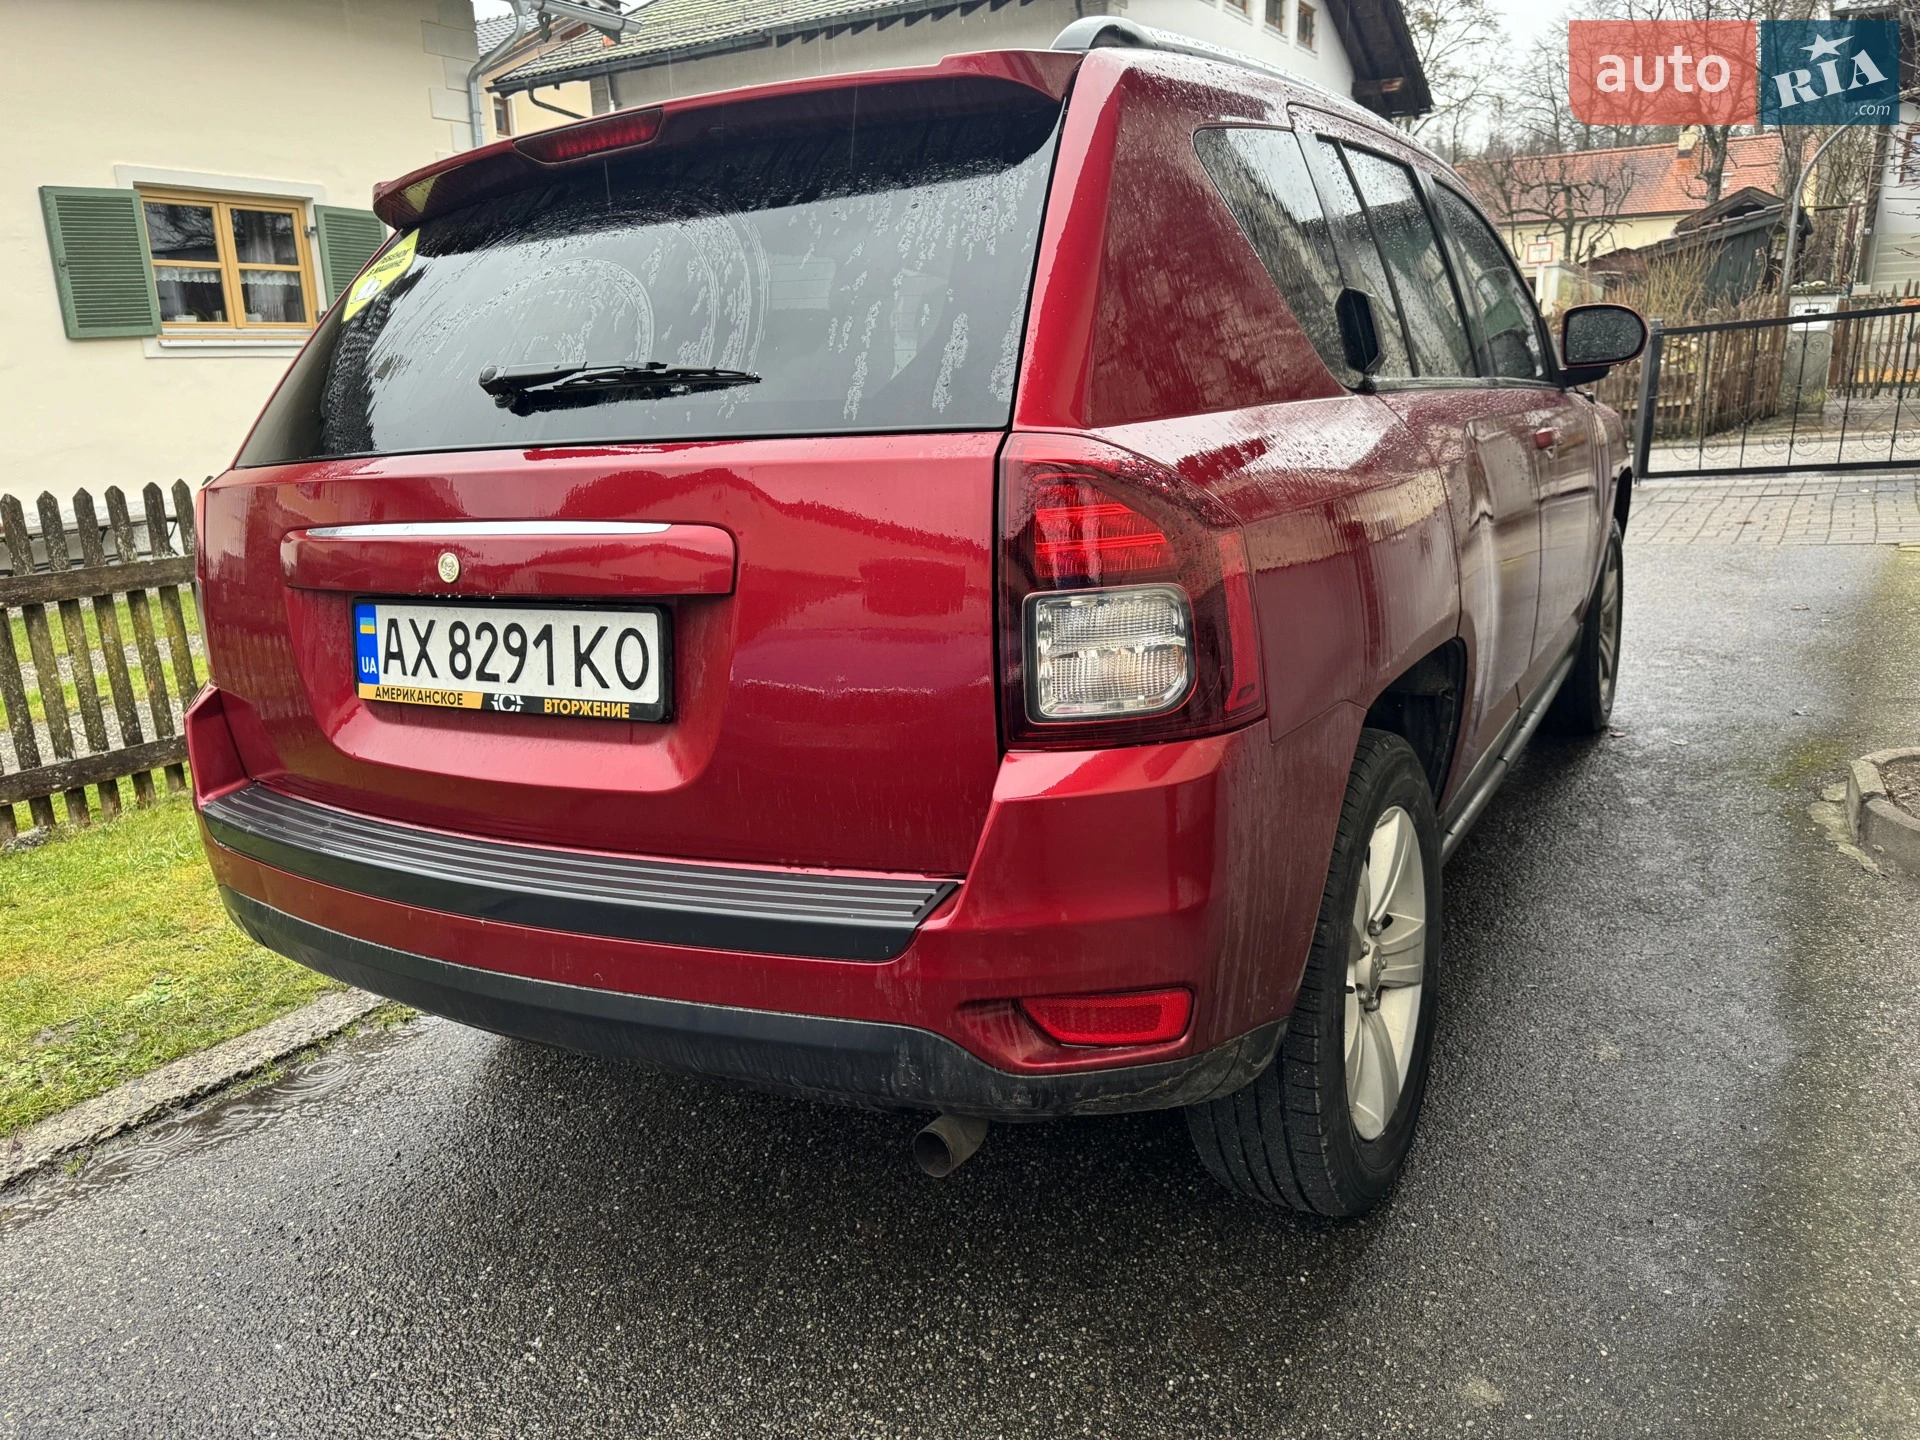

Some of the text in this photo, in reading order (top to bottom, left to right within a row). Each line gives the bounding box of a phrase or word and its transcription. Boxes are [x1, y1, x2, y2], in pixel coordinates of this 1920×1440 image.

[383, 618, 650, 690] AX 8291 KO
[361, 657, 377, 674] UA
[375, 686, 463, 706] АМЕРИКАНСКОЕ
[544, 698, 630, 718] ВТОРЖЕНИЕ
